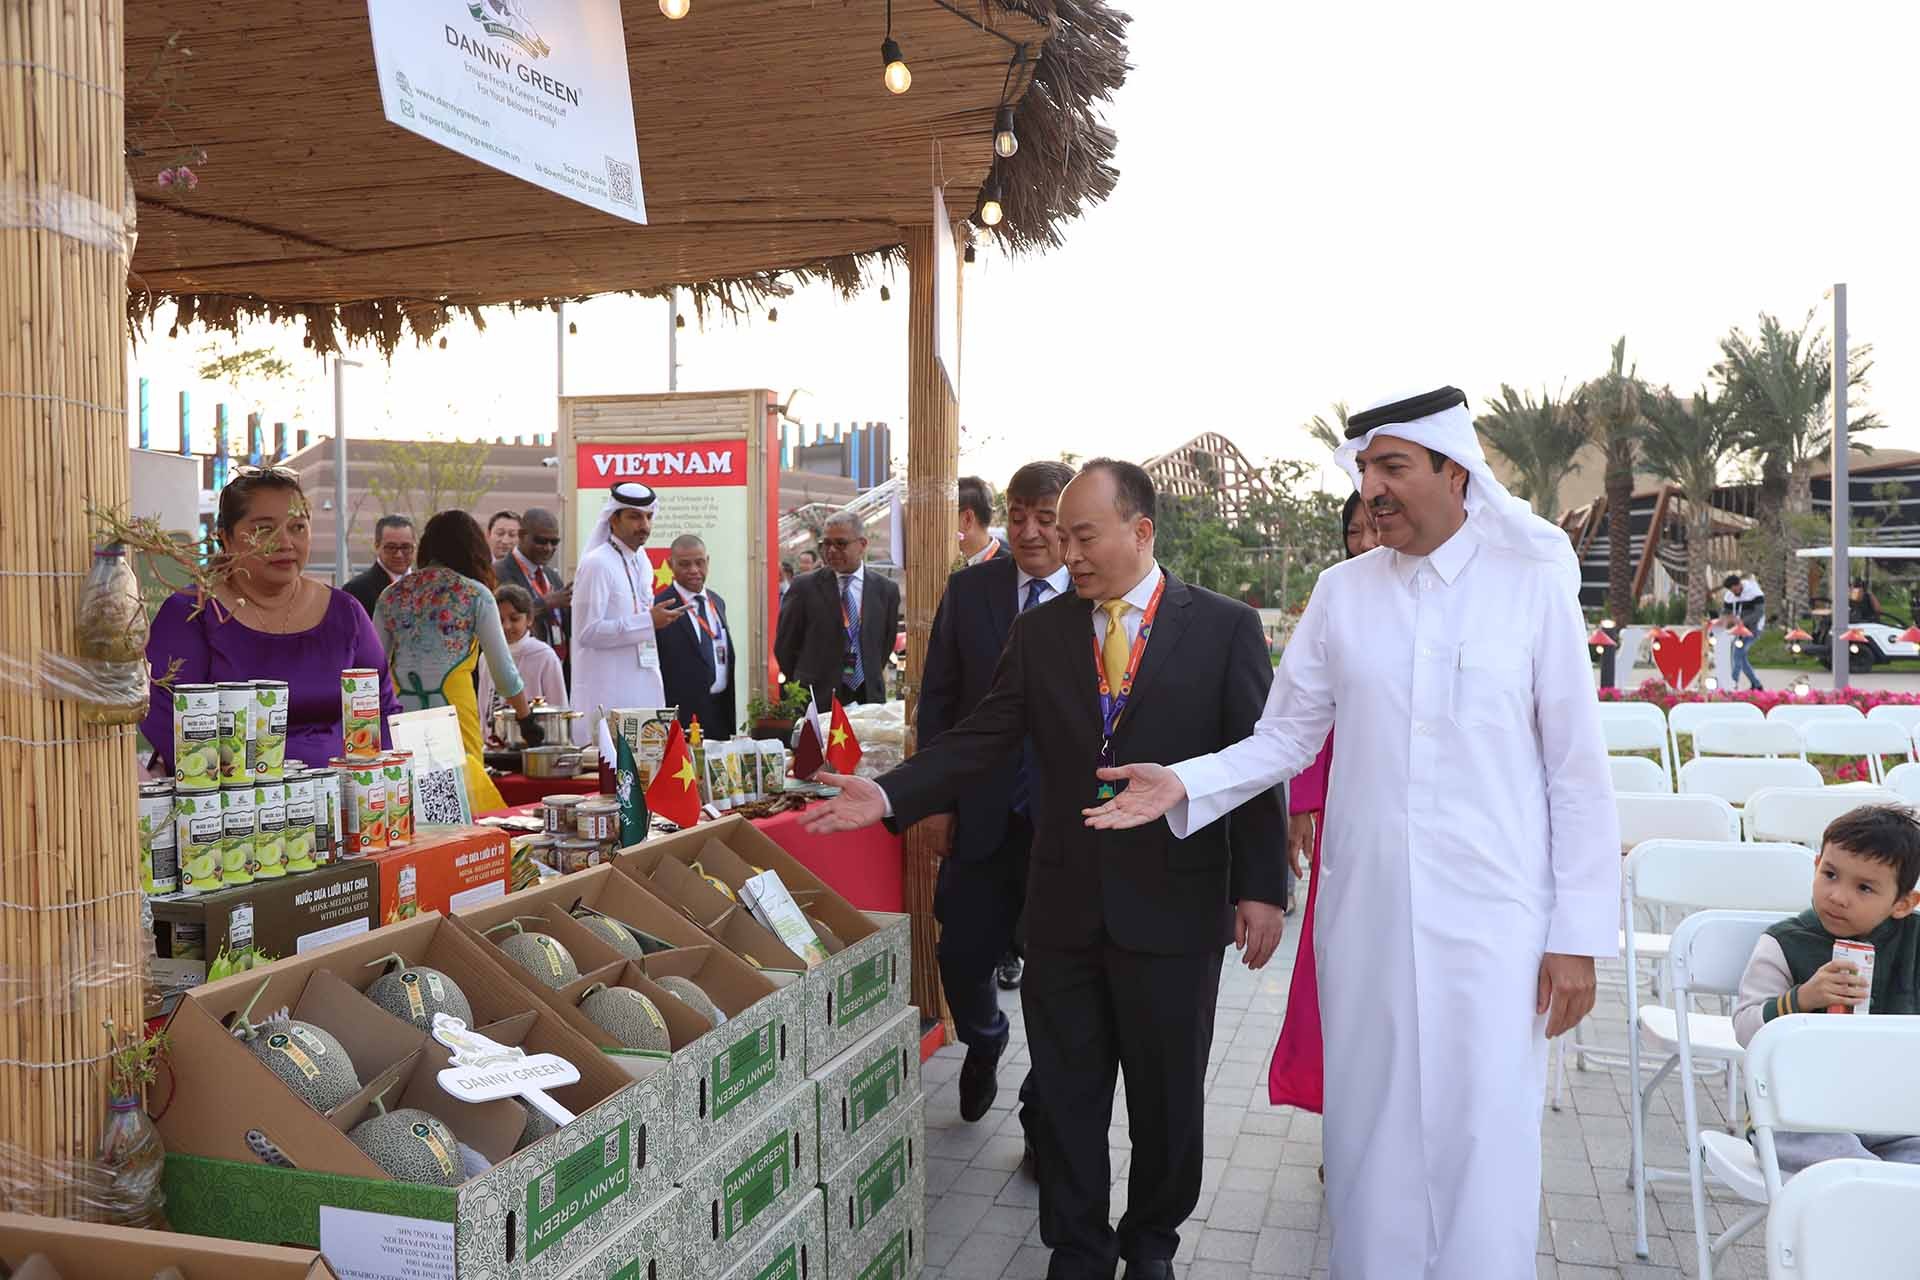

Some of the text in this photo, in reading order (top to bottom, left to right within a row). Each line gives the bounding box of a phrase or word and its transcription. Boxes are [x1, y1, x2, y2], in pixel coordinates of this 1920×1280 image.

[445, 24, 511, 74] DANNY
[517, 63, 579, 107] GREEN
[592, 451, 732, 476] VIETNAM
[354, 876, 369, 890] CHIA
[309, 895, 352, 913] MUSK-MELON
[320, 911, 337, 920] WITH
[353, 901, 369, 912] SEED
[457, 1063, 565, 1090] DANNY GREEN
[716, 1057, 773, 1109] DANNY GREEN
[852, 1057, 896, 1099] DANNY GREEN
[726, 1141, 785, 1199] DANNY GREEN
[582, 1167, 625, 1209] DANNY
[533, 1200, 579, 1245] GREEN
[419, 1241, 453, 1252] VIETNAM
